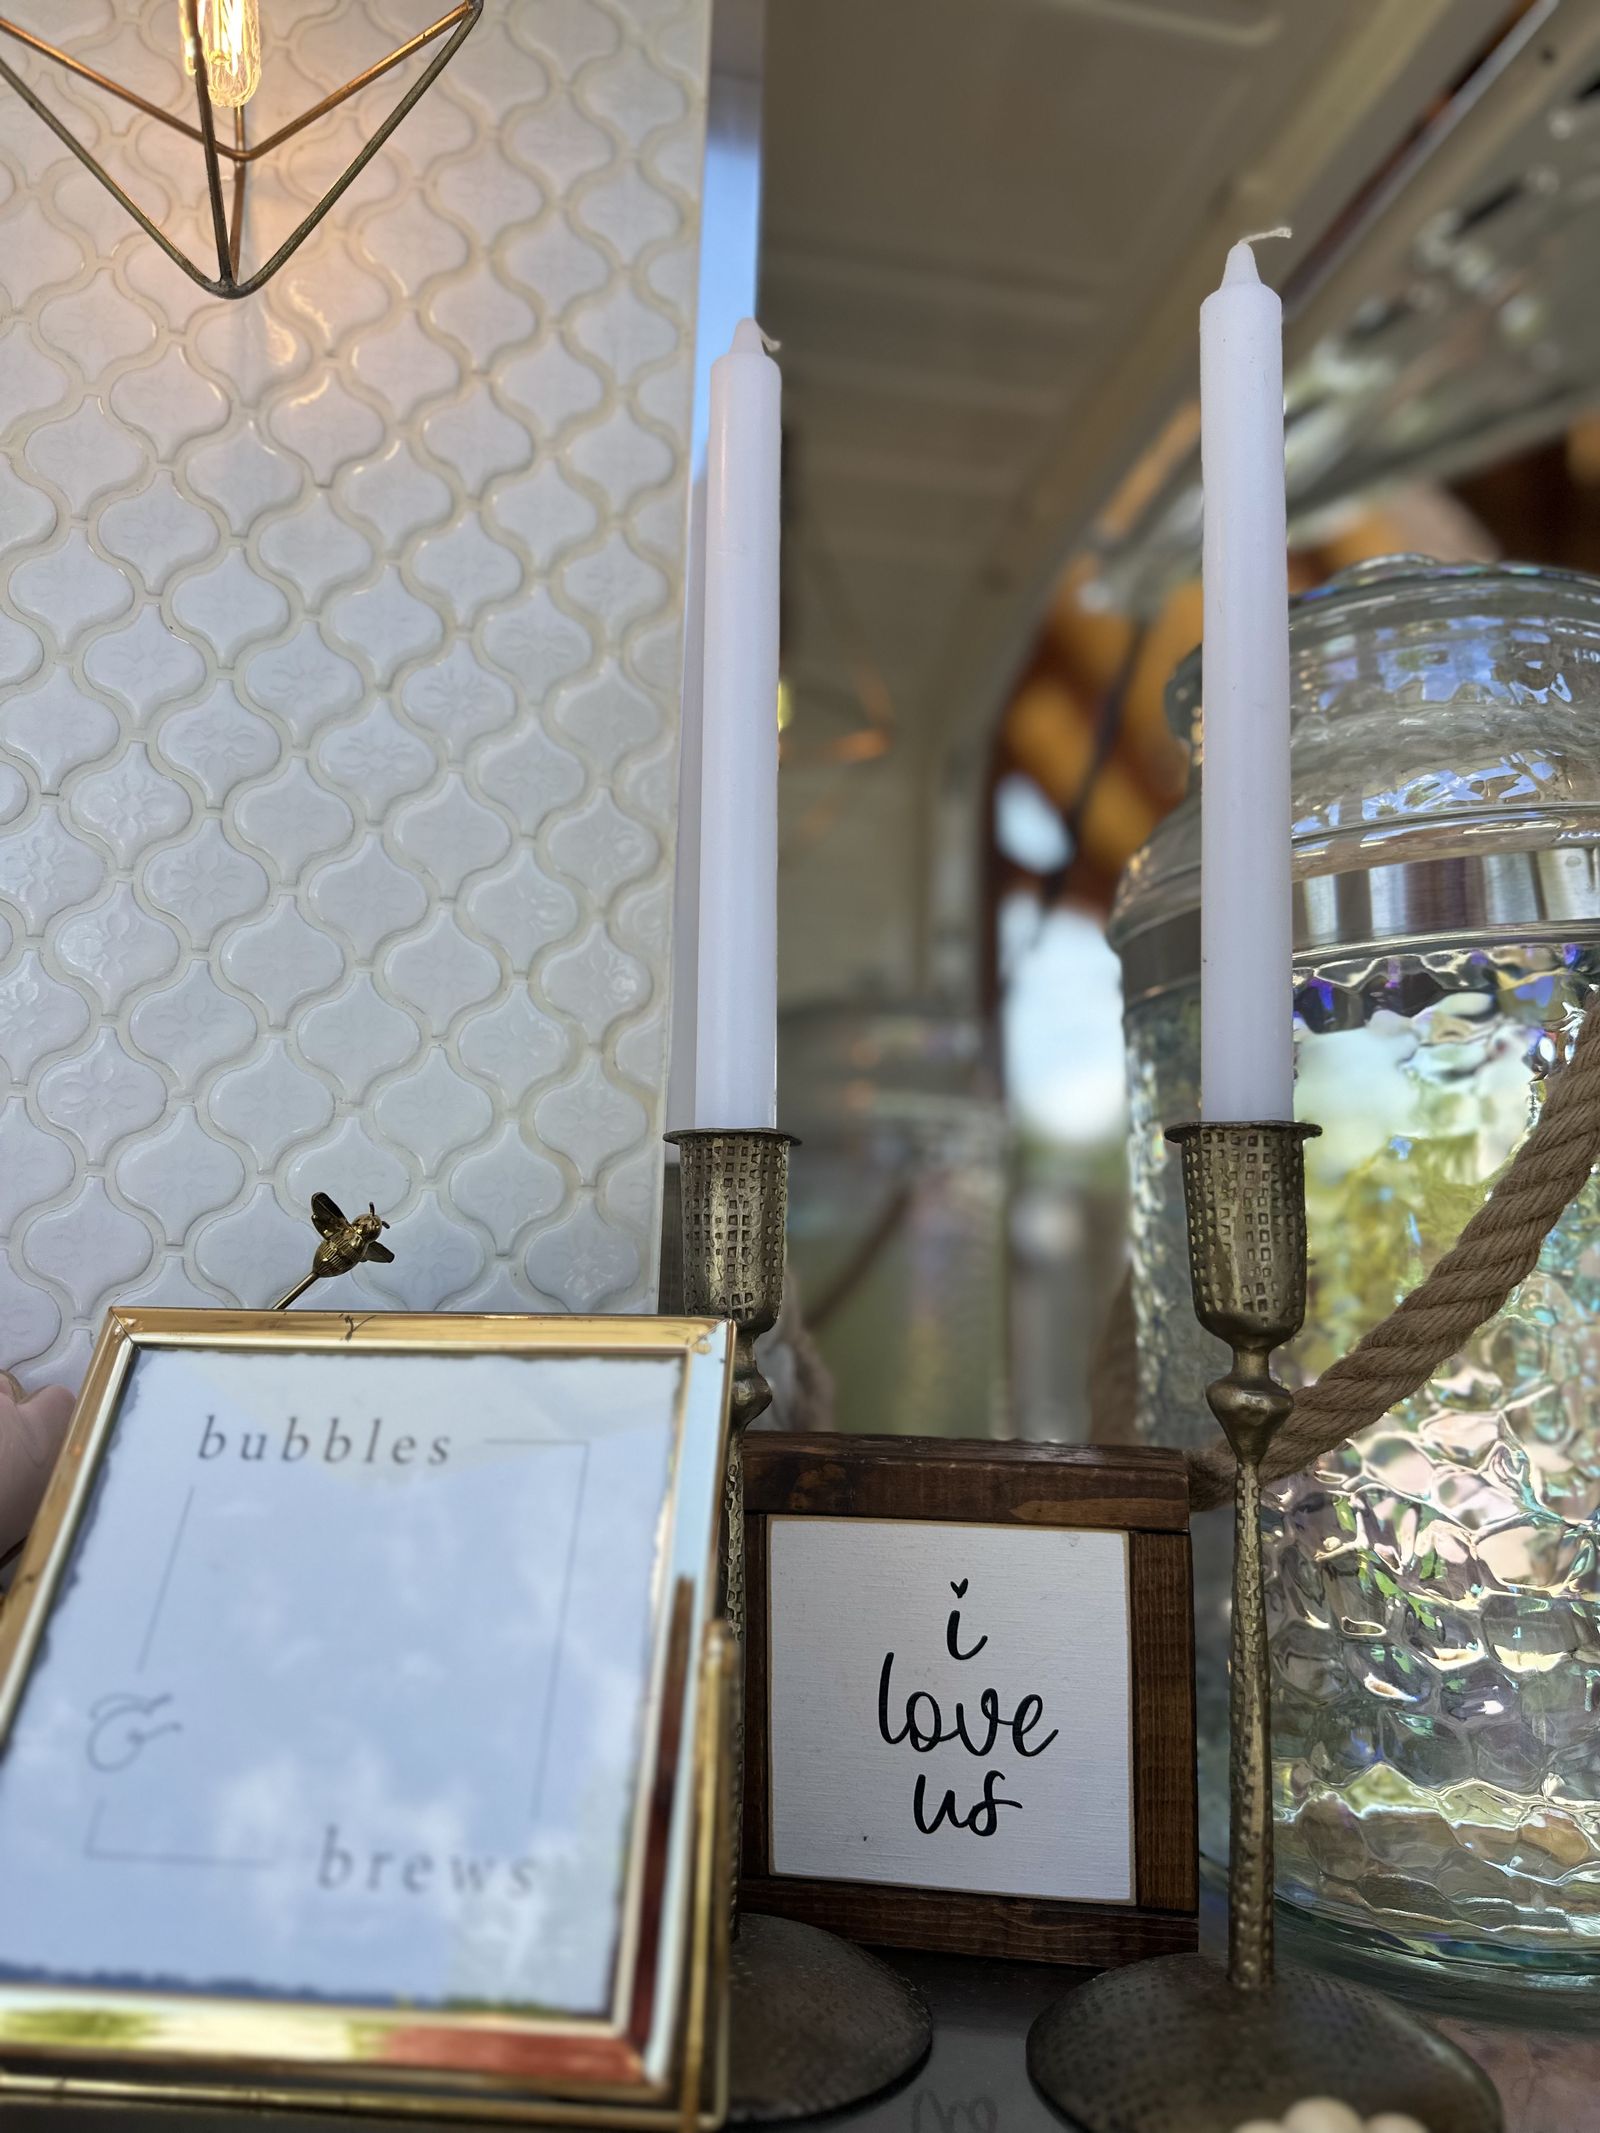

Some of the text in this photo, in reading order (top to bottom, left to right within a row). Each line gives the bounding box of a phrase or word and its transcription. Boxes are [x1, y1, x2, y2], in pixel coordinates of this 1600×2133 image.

[197, 1414, 452, 1465] bubbles
[878, 1652, 1059, 1757] love
[912, 1770, 1023, 1836] us
[317, 1826, 539, 1896] brews
